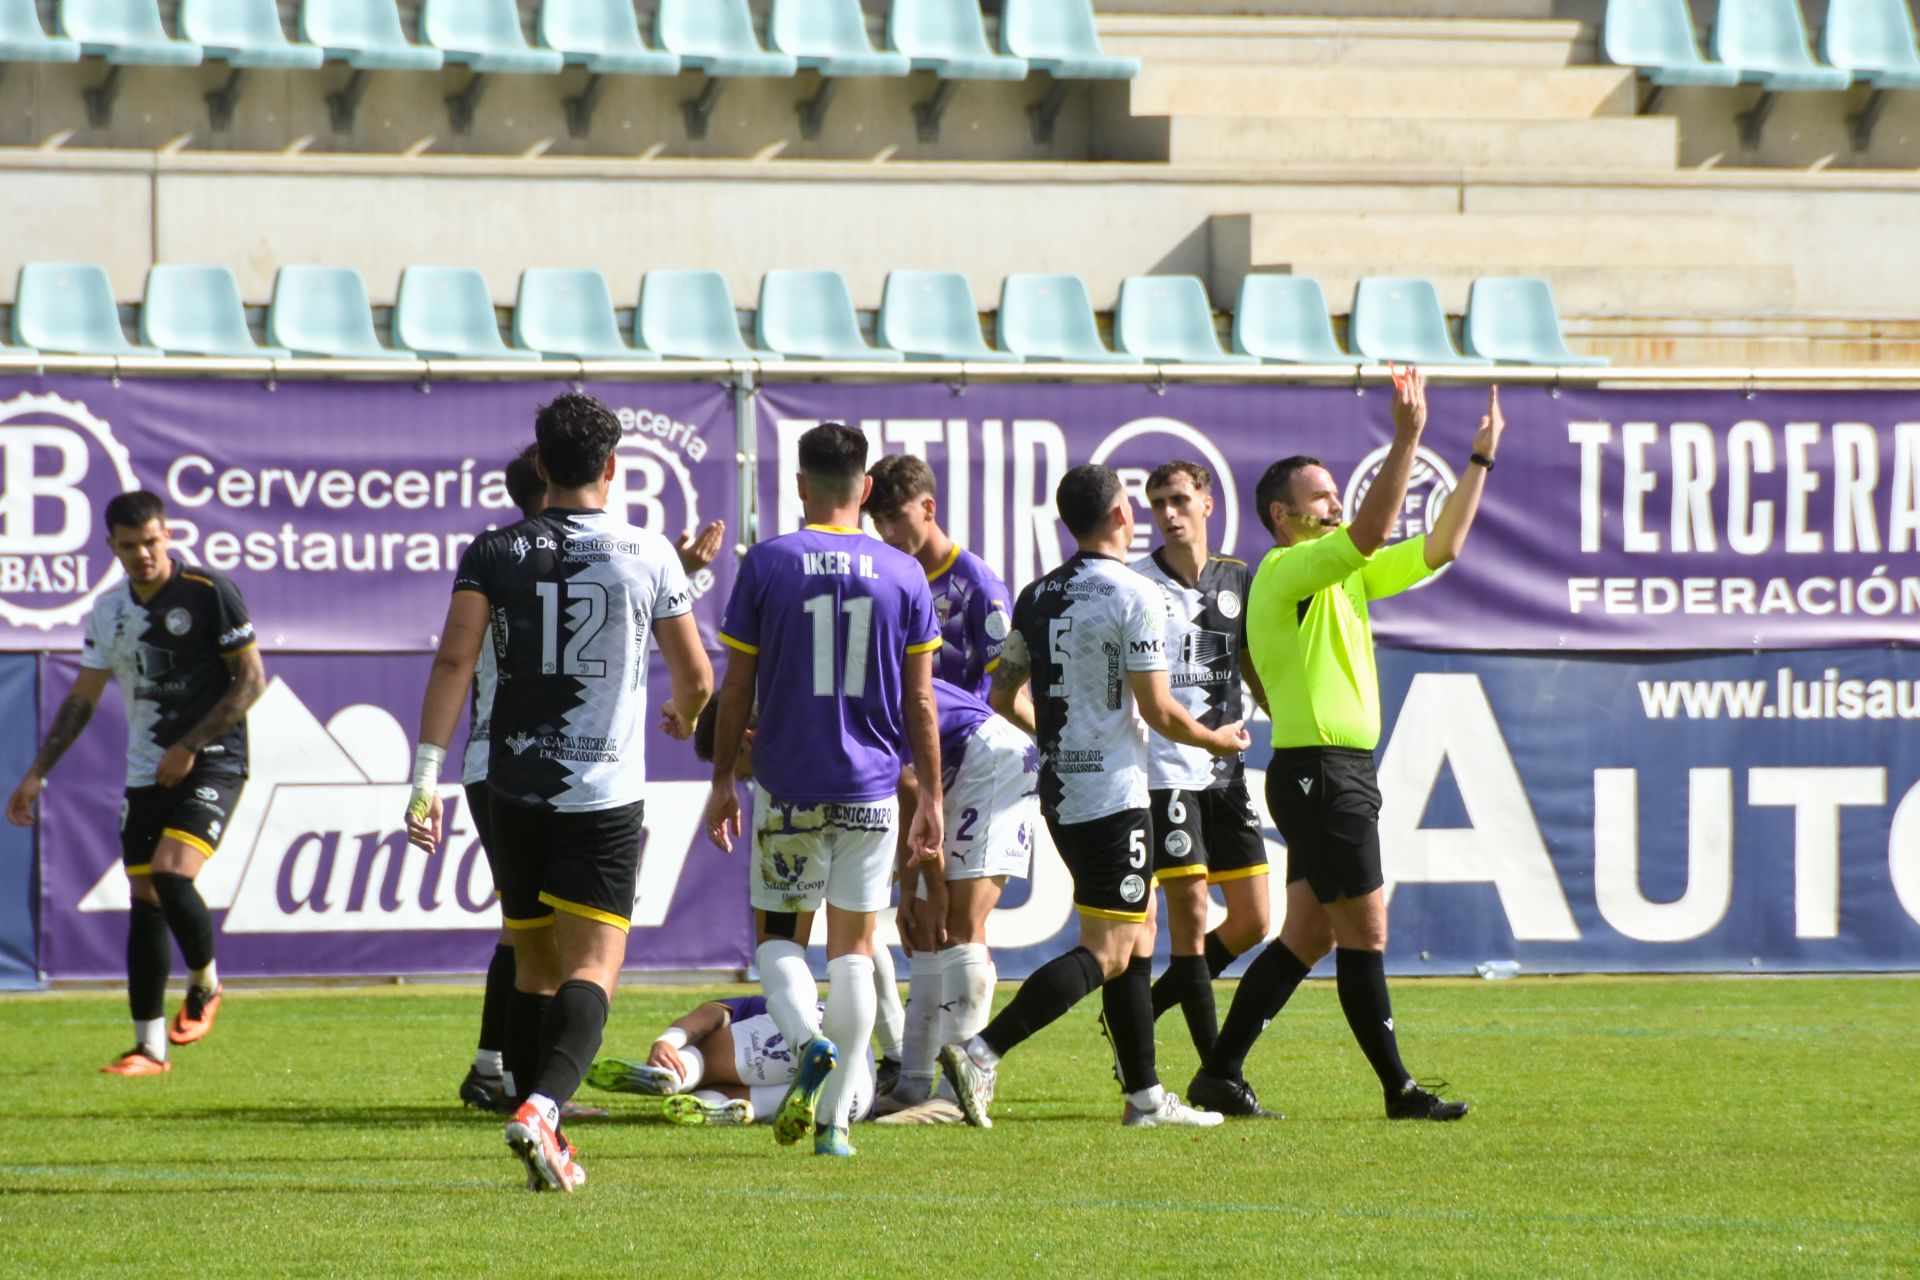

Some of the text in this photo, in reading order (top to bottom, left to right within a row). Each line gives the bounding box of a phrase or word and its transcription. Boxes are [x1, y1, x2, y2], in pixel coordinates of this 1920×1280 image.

[616, 407, 708, 464] ecería
[166, 454, 515, 508] Cervecería
[166, 523, 497, 571] Restauran
[536, 536, 558, 550] De
[562, 539, 614, 552] Castro
[803, 552, 879, 580] IKER H.
[535, 580, 609, 678] 12
[802, 593, 874, 698] 11
[956, 807, 978, 841] 2
[1167, 788, 1187, 824] 6
[1129, 829, 1146, 869] 5
